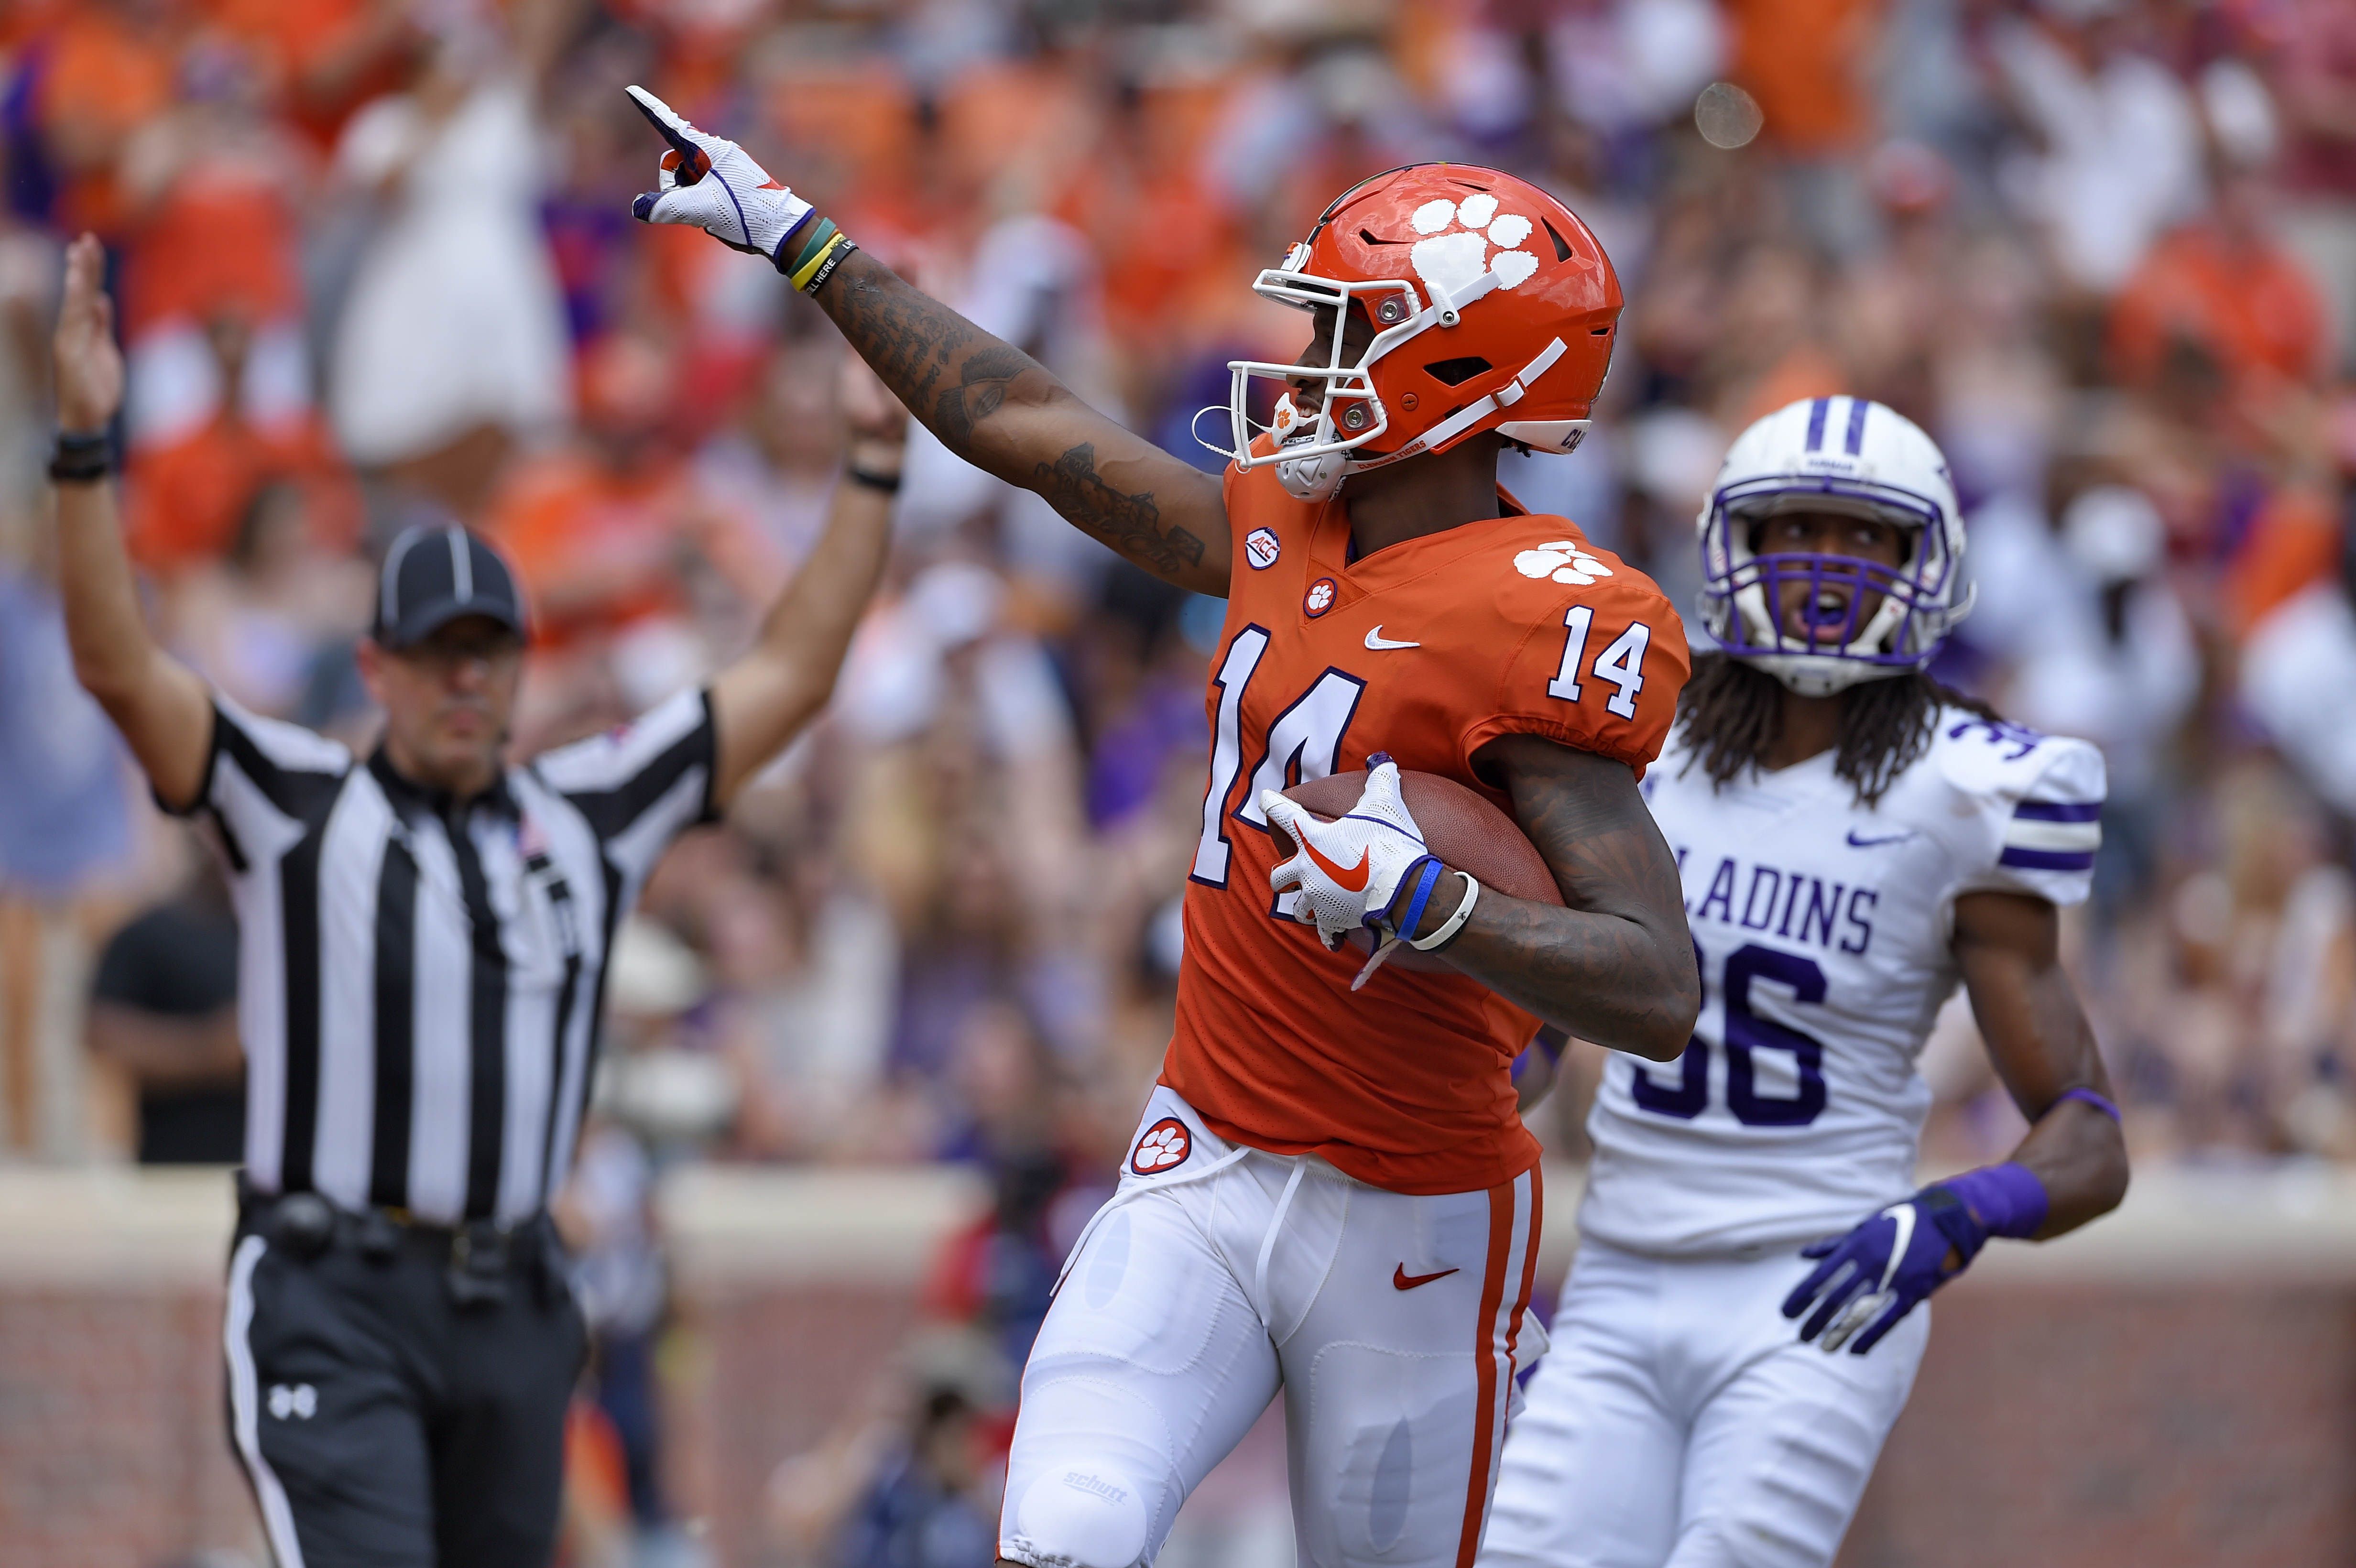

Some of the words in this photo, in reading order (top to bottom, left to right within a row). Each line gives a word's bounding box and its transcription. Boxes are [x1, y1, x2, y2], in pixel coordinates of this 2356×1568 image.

[814, 258, 837, 283] HERE
[1397, 439, 1427, 457] TIGERS
[1251, 536, 1277, 560] ACC
[1546, 604, 1652, 721] 14
[1189, 622, 1368, 925] 14
[1064, 1472, 1127, 1503] schutt
